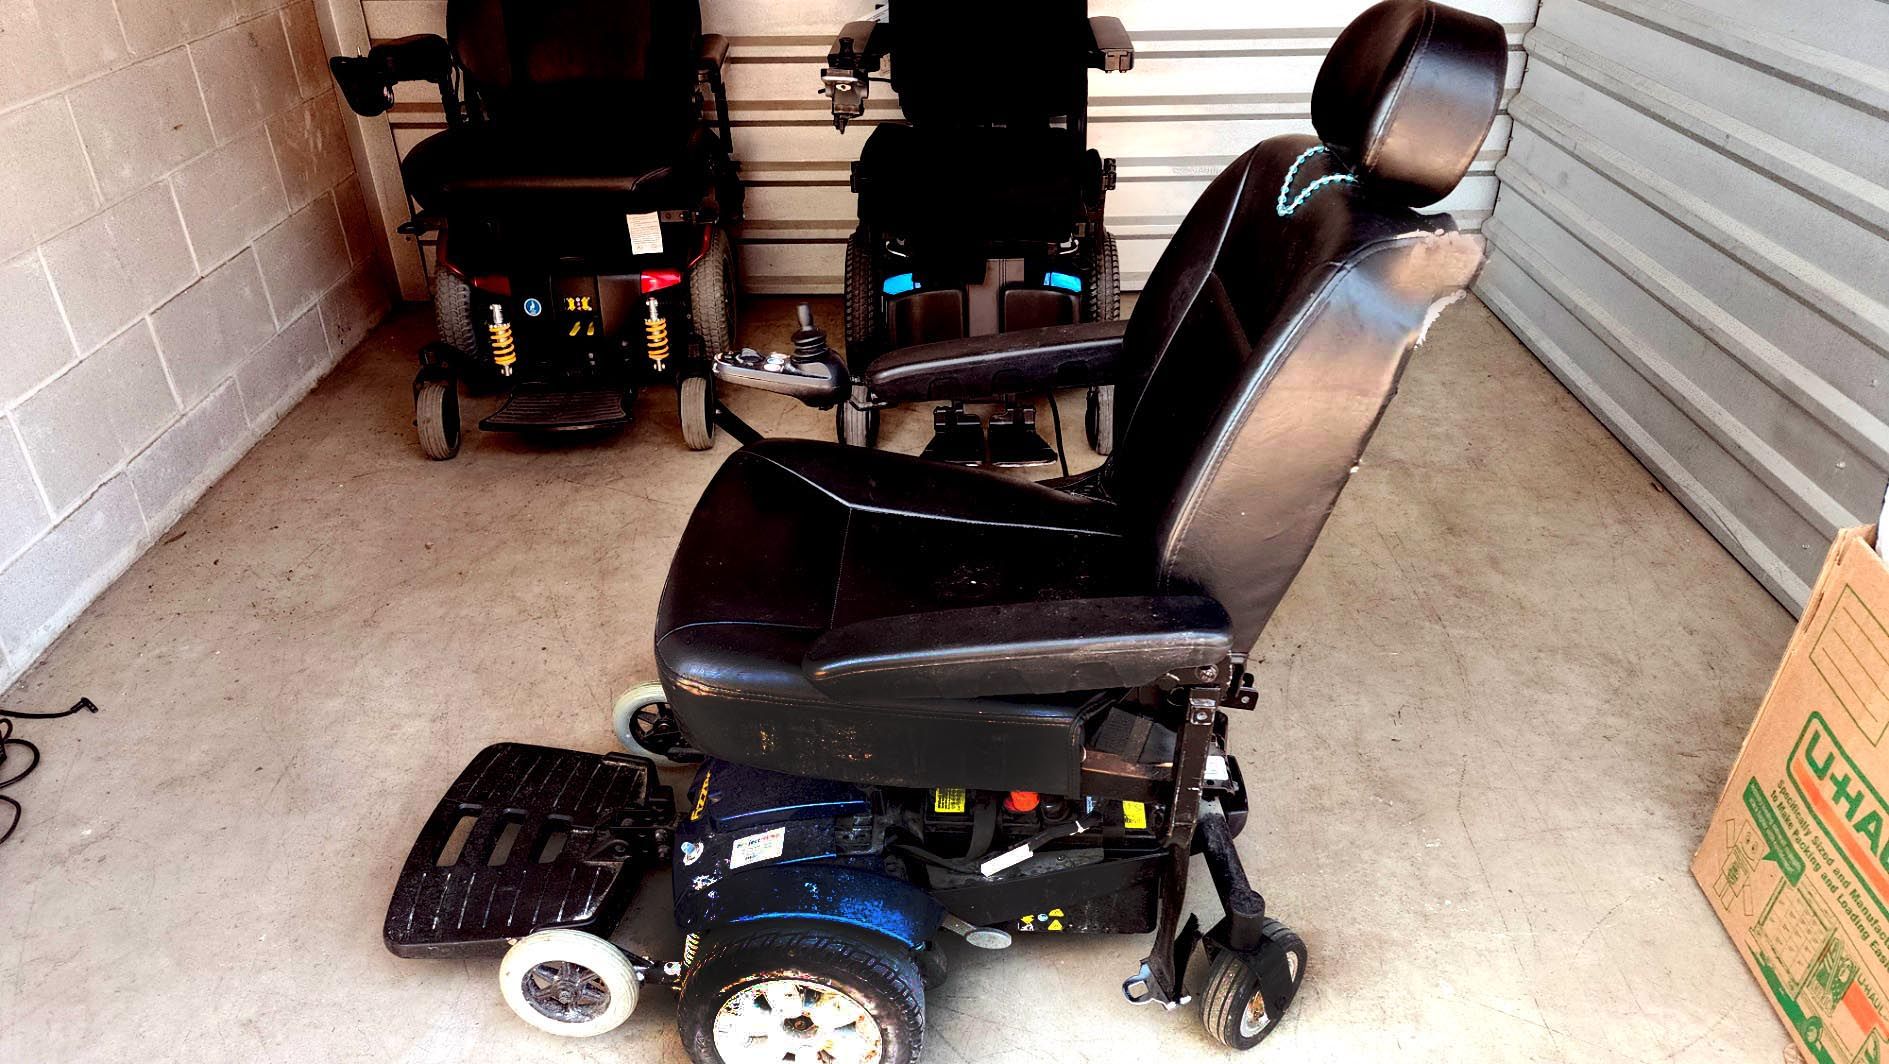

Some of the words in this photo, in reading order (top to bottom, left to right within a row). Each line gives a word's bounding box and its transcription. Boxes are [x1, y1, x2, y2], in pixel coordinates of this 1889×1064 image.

[1770, 790, 1779, 803] to
[1777, 802, 1794, 830] Make
[1792, 828, 1822, 872] Packing
[1820, 872, 1839, 894] and
[1836, 893, 1870, 941] Loading
[1869, 939, 1889, 973] Easi
[1777, 780, 1812, 837] Specifically
[1811, 835, 1835, 866] Sized
[1833, 867, 1852, 889] and
[1849, 888, 1889, 950] Manufact
